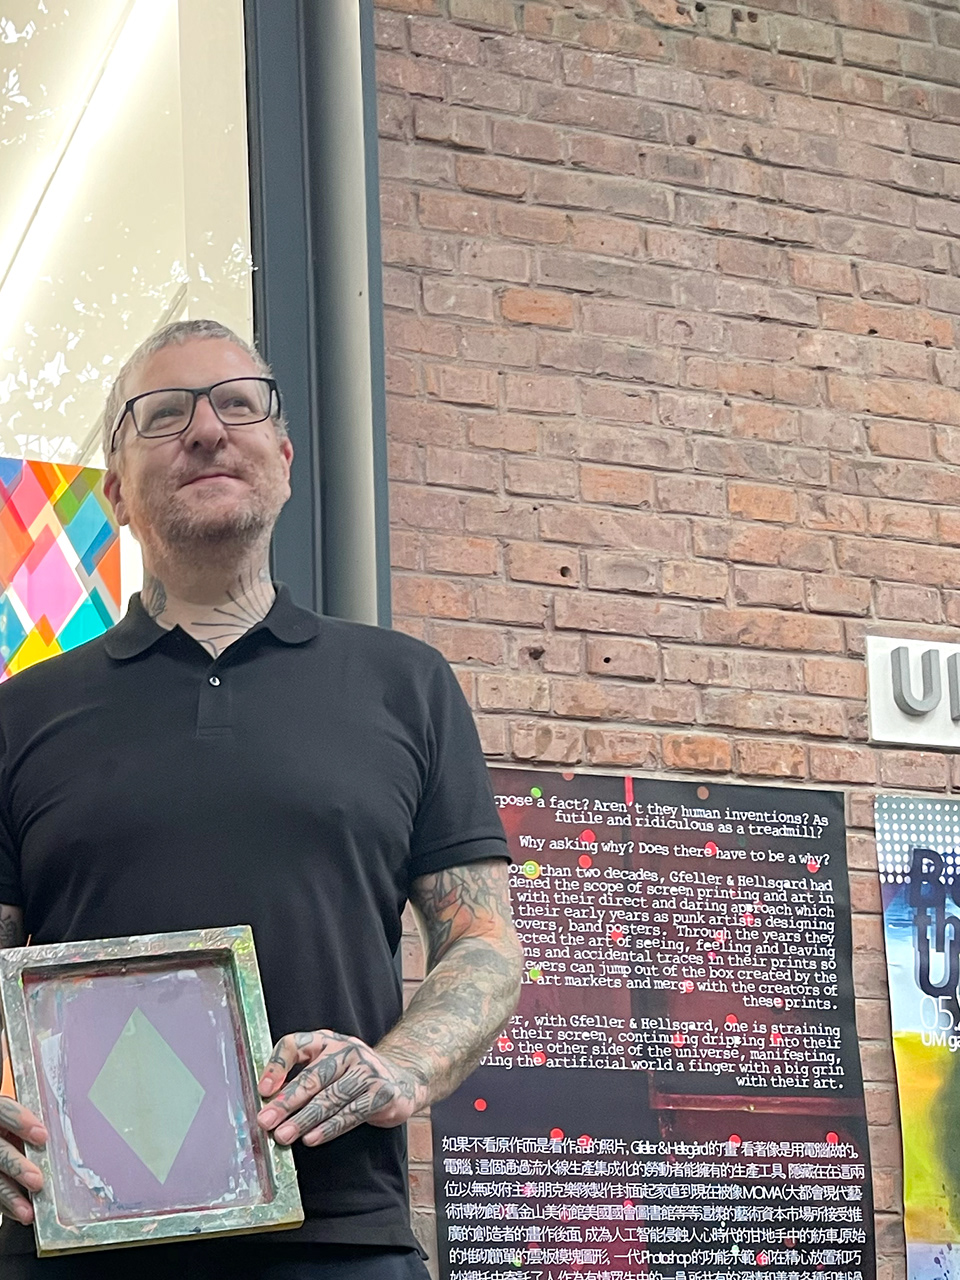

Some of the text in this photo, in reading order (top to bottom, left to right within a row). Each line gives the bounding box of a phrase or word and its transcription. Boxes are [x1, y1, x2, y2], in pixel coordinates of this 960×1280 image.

[536, 798, 546, 808] a
[549, 796, 589, 811] fact?
[592, 799, 644, 814] Aren't
[646, 803, 678, 819] they
[681, 805, 721, 819] human
[724, 808, 809, 825] inventions?
[812, 814, 829, 827] As
[554, 810, 822, 840] futile and ridiculous as a treadmill?
[519, 836, 830, 868] Why asking why? Does there have to be a why?
[537, 864, 572, 877] than
[575, 866, 601, 879] two
[603, 867, 665, 884] decades,
[669, 871, 723, 885] Gfeller
[726, 874, 735, 886] &
[737, 874, 808, 891] Hellsgard
[810, 878, 833, 891] had
[553, 878, 580, 891] the
[583, 882, 624, 896] scope
[626, 882, 642, 895] of
[646, 885, 694, 897] screen
[696, 886, 760, 903] printing
[763, 890, 788, 902] and
[790, 891, 815, 903] art
[818, 892, 834, 904] in
[516, 891, 550, 904] with
[553, 892, 595, 906] their
[598, 895, 648, 909] direct
[651, 898, 677, 910] and
[679, 899, 728, 916] daring
[730, 904, 793, 917] approach
[794, 905, 835, 918] which
[517, 904, 560, 918] their
[563, 907, 606, 922] early
[608, 910, 650, 923] years
[653, 912, 669, 923] as
[672, 912, 706, 926] punk
[708, 913, 762, 927] artists
[764, 915, 835, 933] designing
[568, 919, 603, 933] band
[605, 922, 667, 936] posters.
[675, 924, 732, 941] Through
[734, 926, 759, 939] the
[761, 930, 801, 943] years
[804, 929, 835, 945] they
[544, 947, 571, 959] and
[573, 948, 653, 963] accidental
[656, 951, 704, 965] traces
[707, 953, 724, 966] in
[727, 954, 768, 968] their
[770, 956, 817, 971] prints
[820, 960, 837, 971] so
[559, 933, 585, 946] the
[588, 935, 614, 947] art
[616, 936, 632, 948] of
[635, 937, 690, 953] seeing,
[695, 938, 752, 955] feeling
[754, 941, 780, 954] and
[782, 942, 836, 959] leaving
[536, 974, 562, 986] art
[564, 975, 622, 988] markets
[625, 977, 652, 989] and
[653, 980, 694, 993] merge
[696, 979, 728, 992] with
[731, 980, 756, 993] the
[758, 983, 820, 996] creators
[823, 984, 838, 996] of
[569, 963, 595, 974] can
[598, 962, 632, 978] jump
[634, 964, 660, 976] out
[662, 965, 678, 977] of
[681, 965, 706, 978] the
[709, 966, 734, 979] box
[736, 969, 792, 981] created
[794, 970, 811, 985] by
[813, 970, 837, 983] the
[742, 994, 838, 1011] these prints.
[511, 1027, 554, 1041] their
[557, 1031, 613, 1044] screen,
[617, 1031, 699, 1048] continuing
[701, 1033, 765, 1050] dripping
[768, 1036, 800, 1049] into
[802, 1037, 842, 1050] their
[533, 1014, 567, 1027] with
[569, 1015, 626, 1029] Gfeller
[629, 1018, 638, 1030] &
[641, 1018, 719, 1035] Hellsgard,
[723, 1023, 748, 1034] one
[752, 1022, 767, 1035] is
[770, 1023, 840, 1040] straining
[497, 1039, 514, 1052] to
[517, 1040, 544, 1053] the
[546, 1041, 588, 1054] other
[591, 1043, 624, 1056] side
[627, 1044, 643, 1056] of
[647, 1044, 672, 1057] the
[674, 1046, 745, 1061] universe,
[749, 1049, 841, 1065] manifesting,
[516, 1056, 543, 1068] the
[545, 1057, 628, 1070] artificial
[630, 1059, 673, 1072] world
[676, 1062, 685, 1072] a
[688, 1060, 736, 1076] finger
[738, 1061, 770, 1074] with
[773, 1064, 782, 1074] a
[784, 1062, 809, 1078] big
[811, 1064, 844, 1078] grin
[735, 1074, 843, 1090] with their art.
